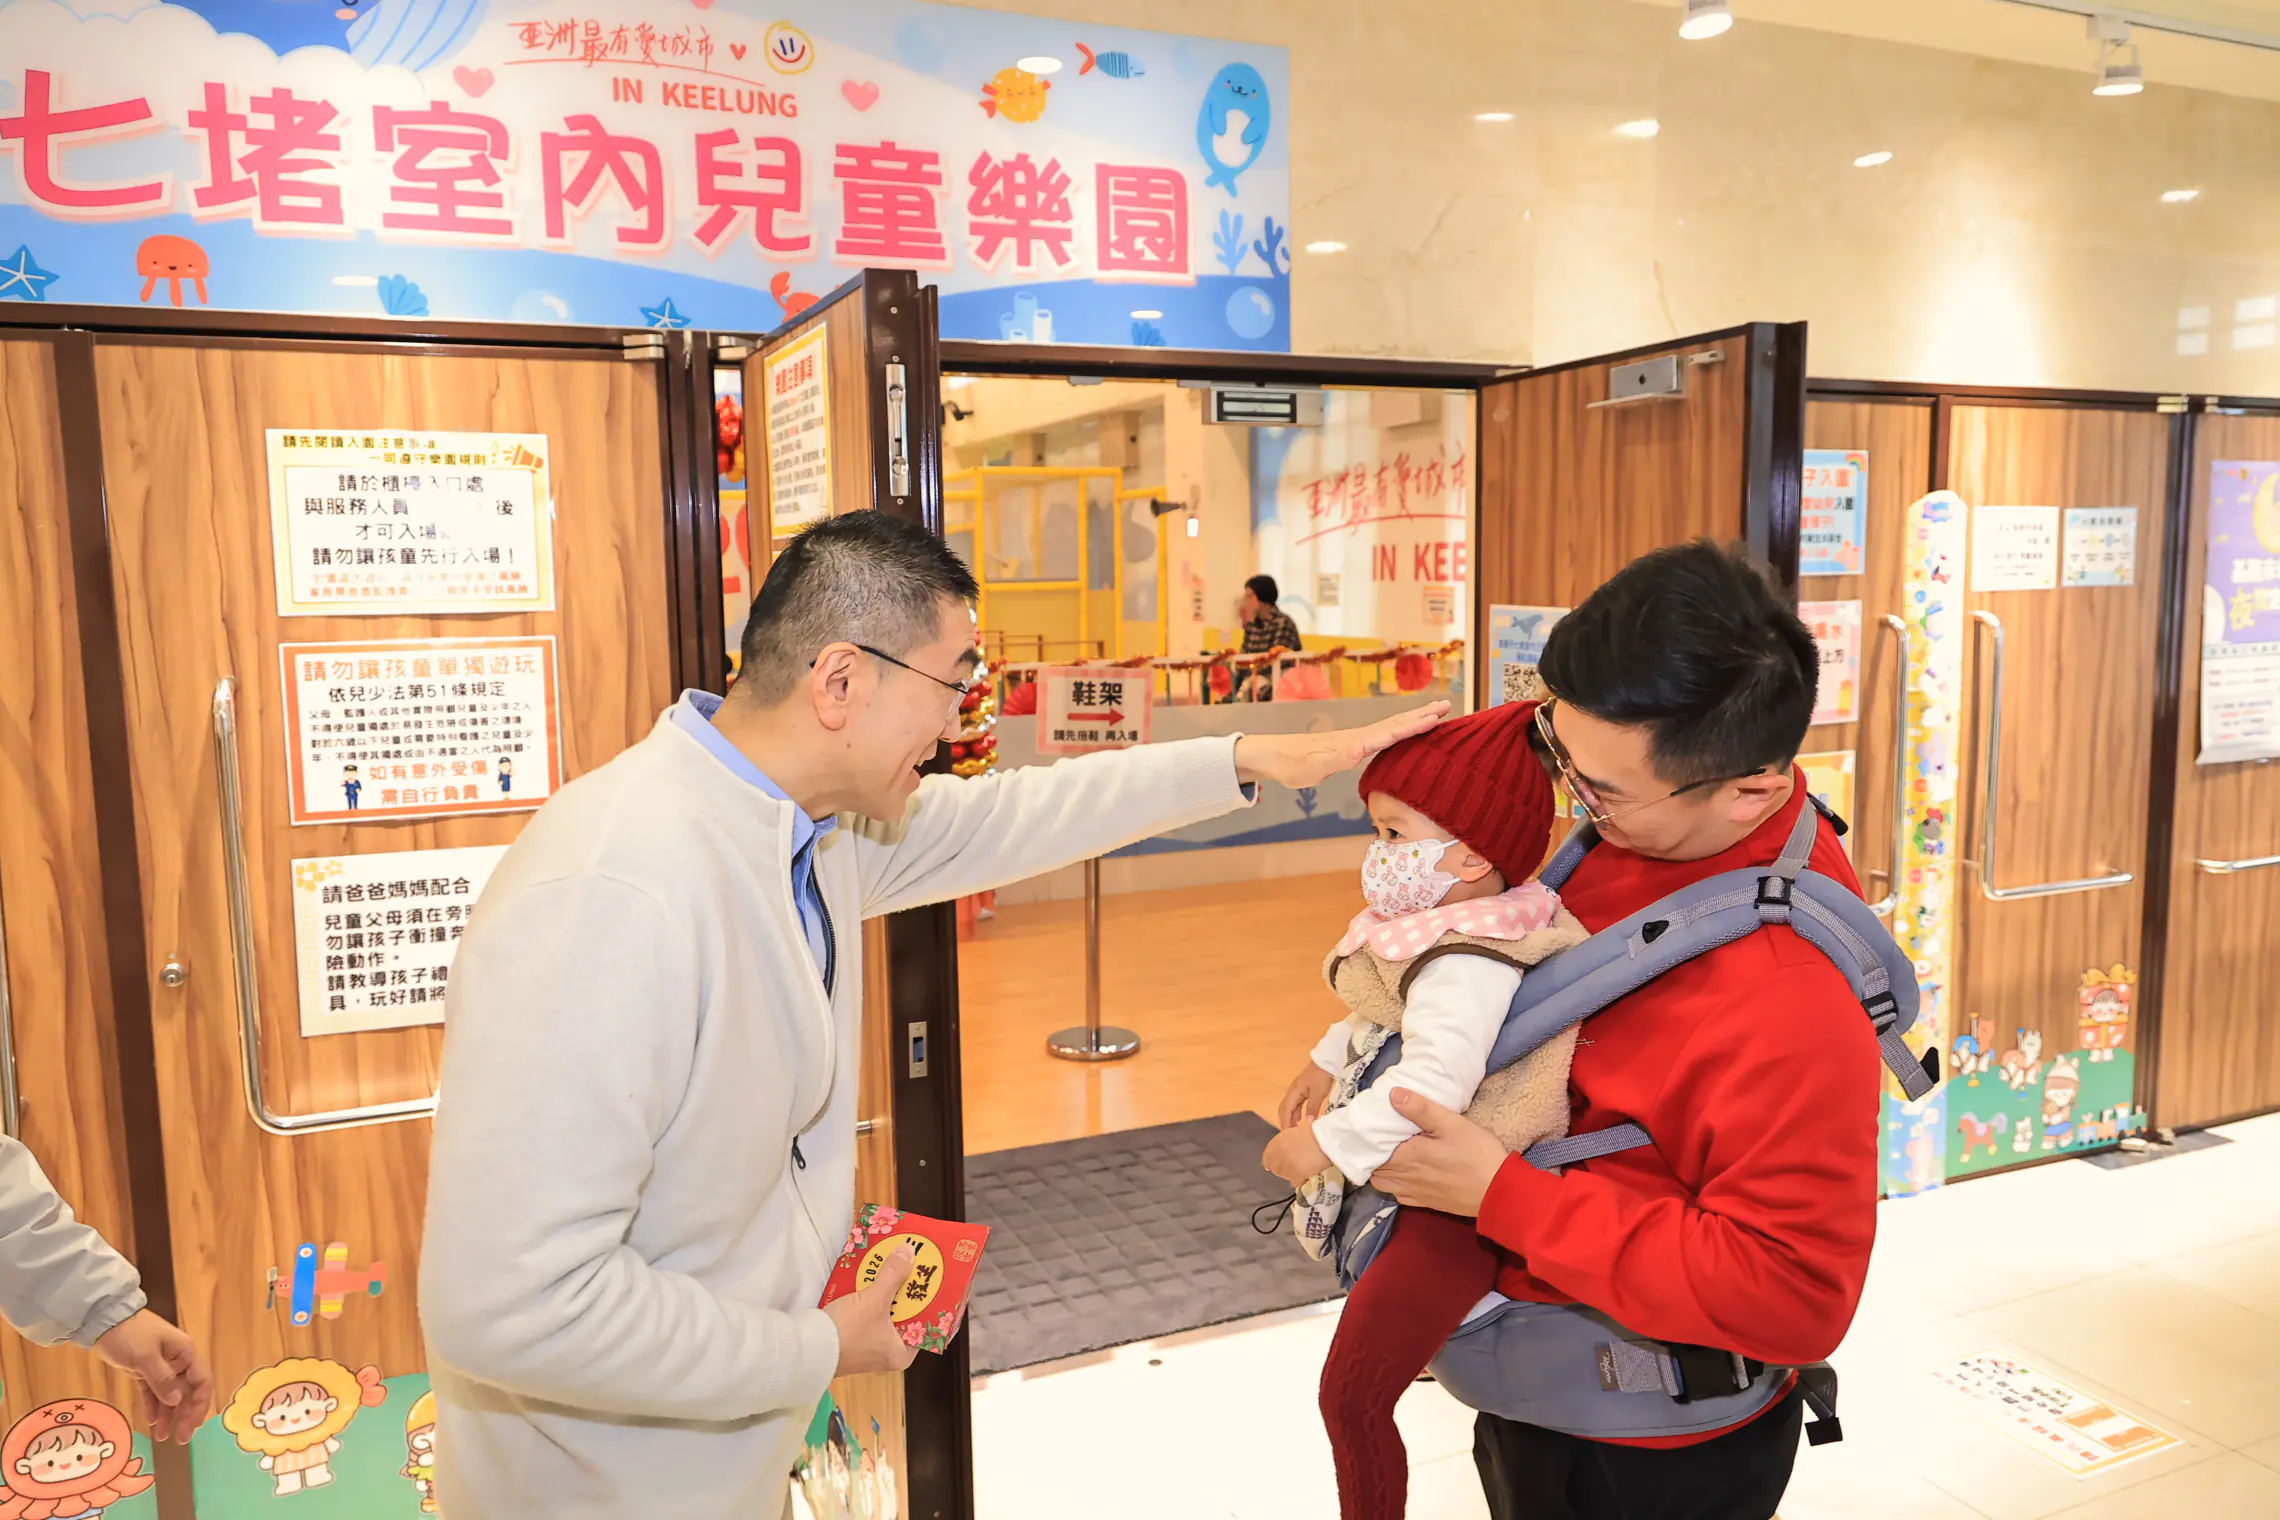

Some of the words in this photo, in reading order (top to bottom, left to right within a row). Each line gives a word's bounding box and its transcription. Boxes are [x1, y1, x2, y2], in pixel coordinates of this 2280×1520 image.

[613, 76, 644, 104] IN
[661, 81, 799, 119] KEELUNG
[0, 69, 1189, 275] 七堵室內兒童樂園
[1372, 544, 1396, 582] IN
[303, 653, 536, 683] 請勿讓孩童單獨遊玩
[328, 681, 506, 704] 依兒少法第51條規定
[1071, 681, 1123, 707] 鞋架
[369, 759, 488, 781] 如有意外受傷
[381, 783, 479, 805] 需自行負責
[322, 876, 471, 905] 請爸爸媽媽配合
[326, 953, 401, 971] 險動作。
[327, 965, 449, 991] 請教導孩子禮
[863, 1253, 884, 1283] 2026
